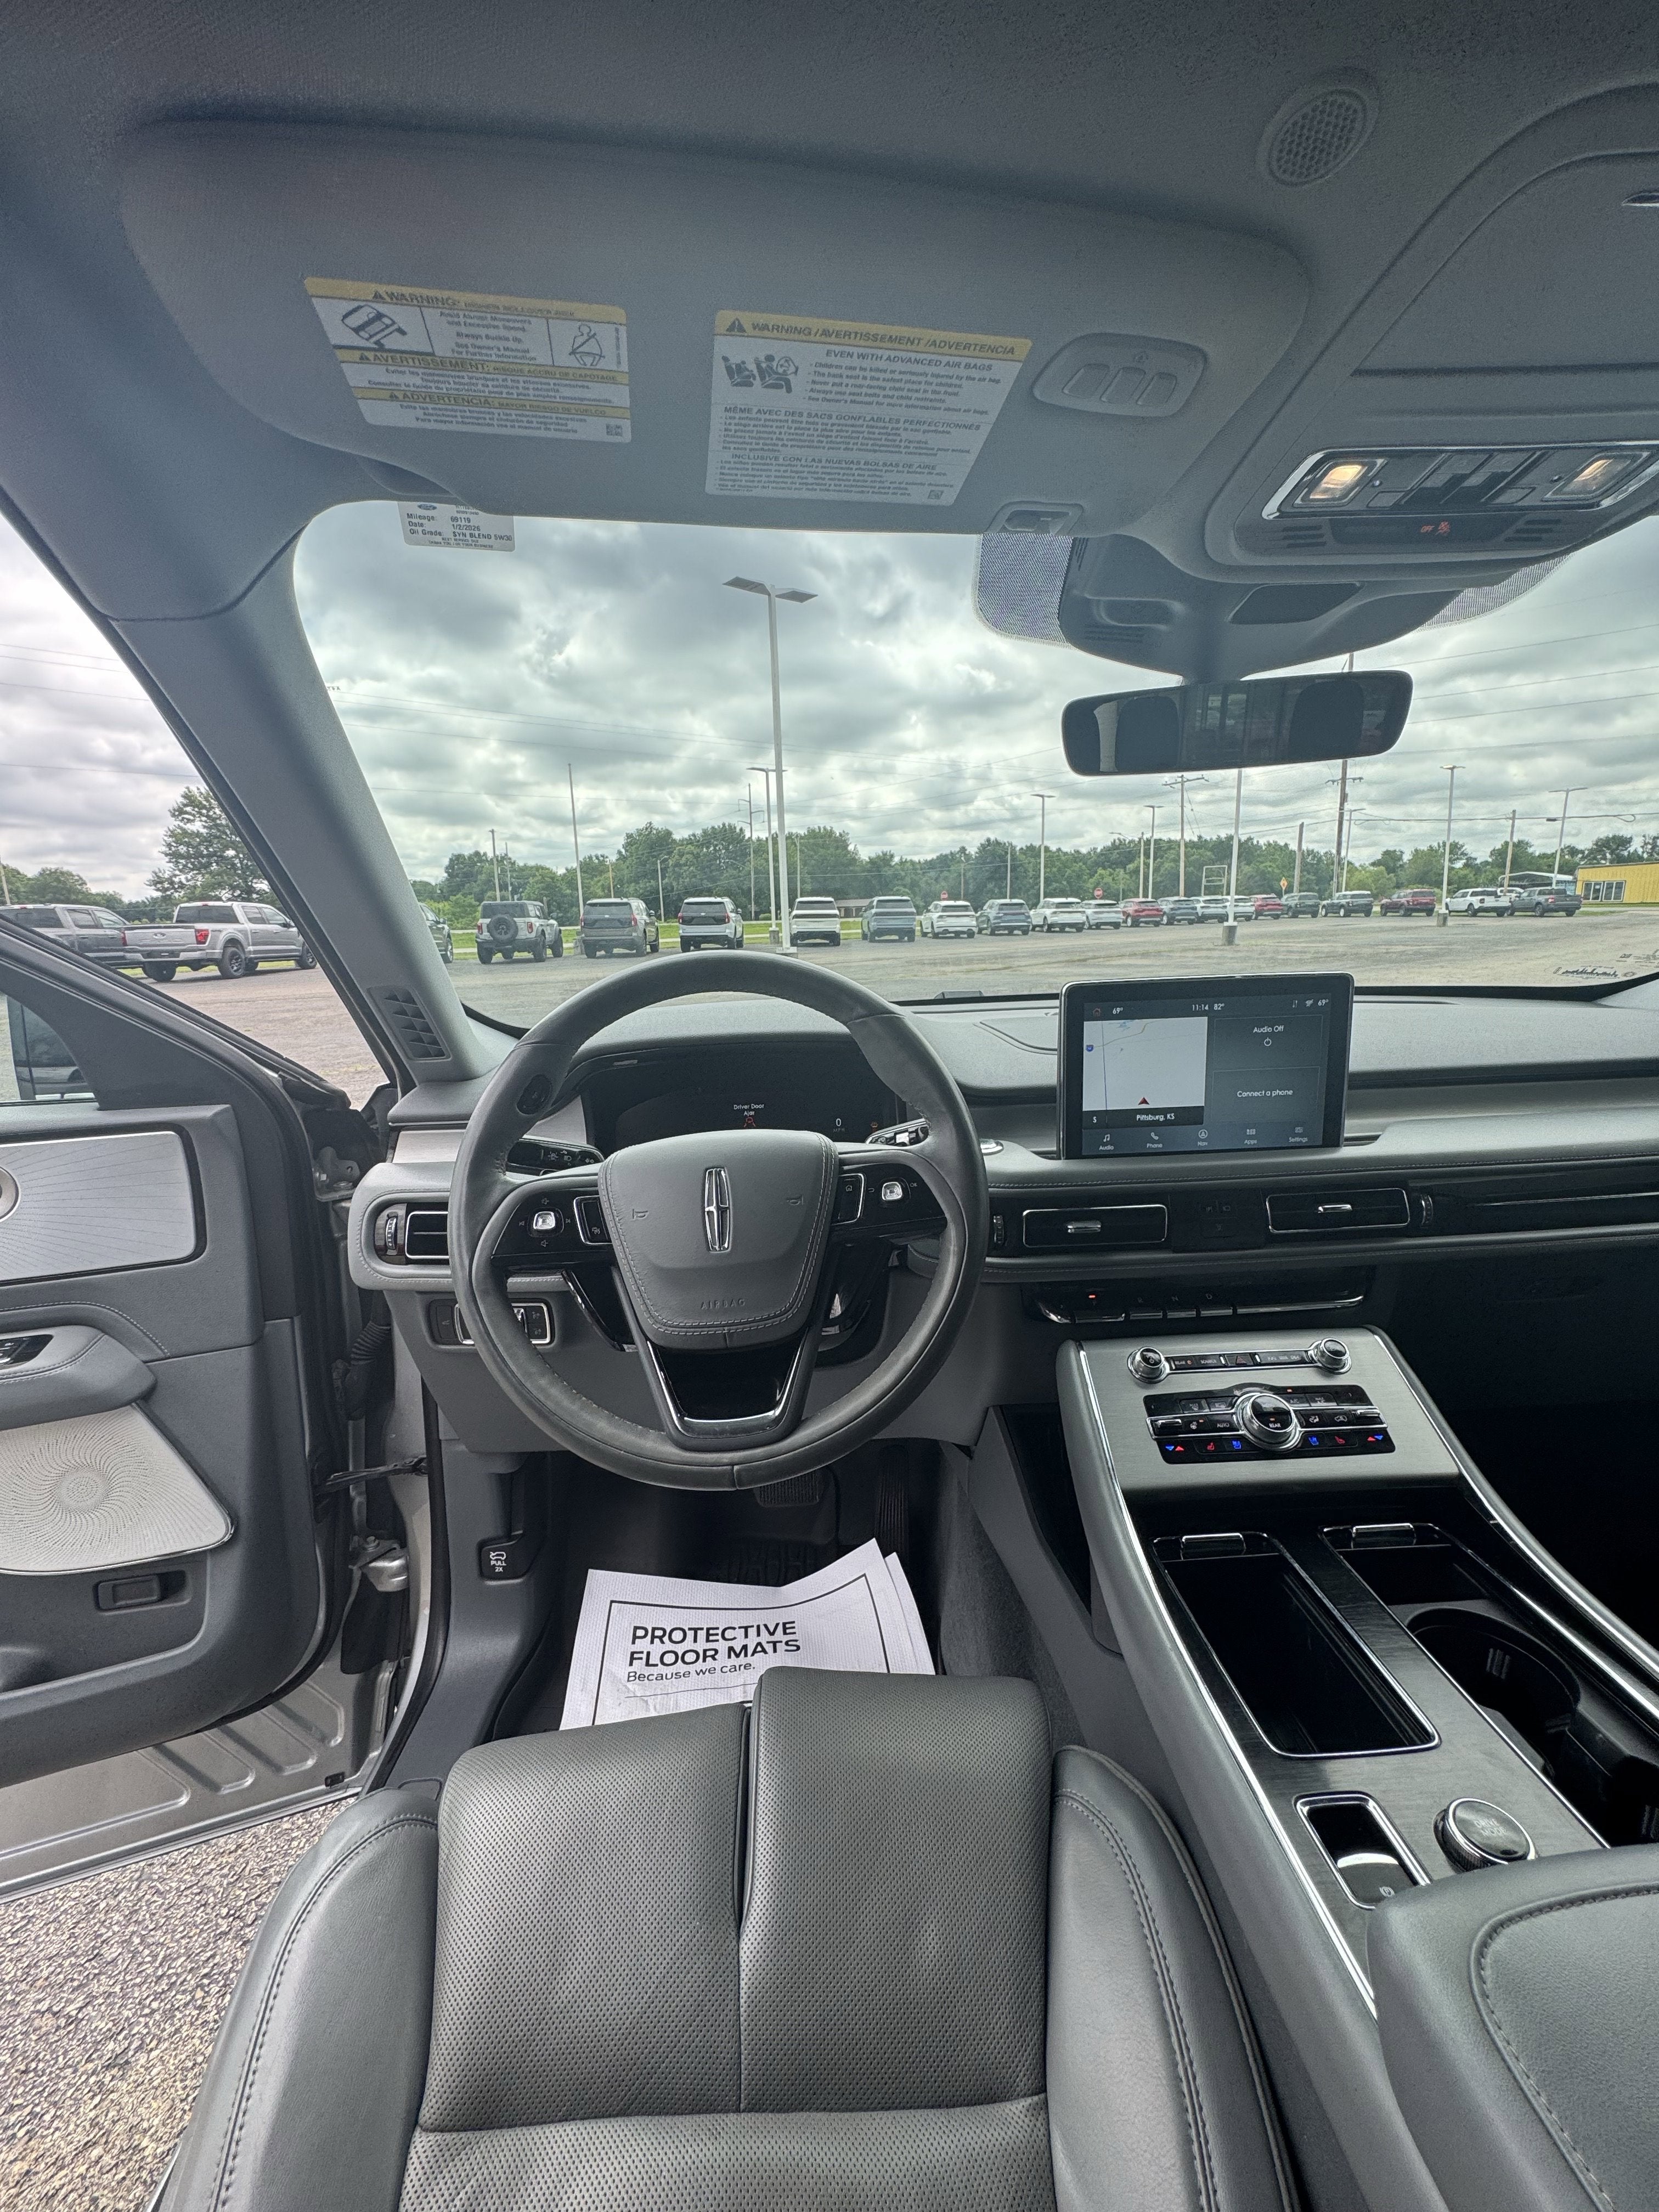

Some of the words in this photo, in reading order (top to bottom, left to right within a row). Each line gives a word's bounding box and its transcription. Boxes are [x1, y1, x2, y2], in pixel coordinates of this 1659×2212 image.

[752, 322, 812, 336] WARNING
[826, 349, 854, 359] EVEN
[856, 352, 883, 362] WITH
[884, 354, 942, 367] ADVANCED
[944, 360, 961, 369] AIR
[963, 362, 993, 371] BAGS
[755, 408, 782, 416] AVEC
[835, 414, 900, 424] GONFLABLES
[732, 453, 780, 462] INCLUSIVE
[825, 458, 861, 466] NUEVAS
[407, 513, 437, 521] Mileage:
[1253, 1025, 1272, 1034] Audio
[1272, 1088, 1294, 1098] phone
[701, 1298, 746, 1310] AIRBAG
[631, 1621, 797, 1645] PROTECTIVE
[628, 1649, 719, 1668] FLOOR
[727, 1639, 801, 1660] MATS
[627, 1671, 691, 1683] Because
[695, 1667, 717, 1677] we
[720, 1662, 755, 1674] care.
[1474, 1817, 1501, 1828] DRIVE
[1481, 1826, 1508, 1836] MODE
